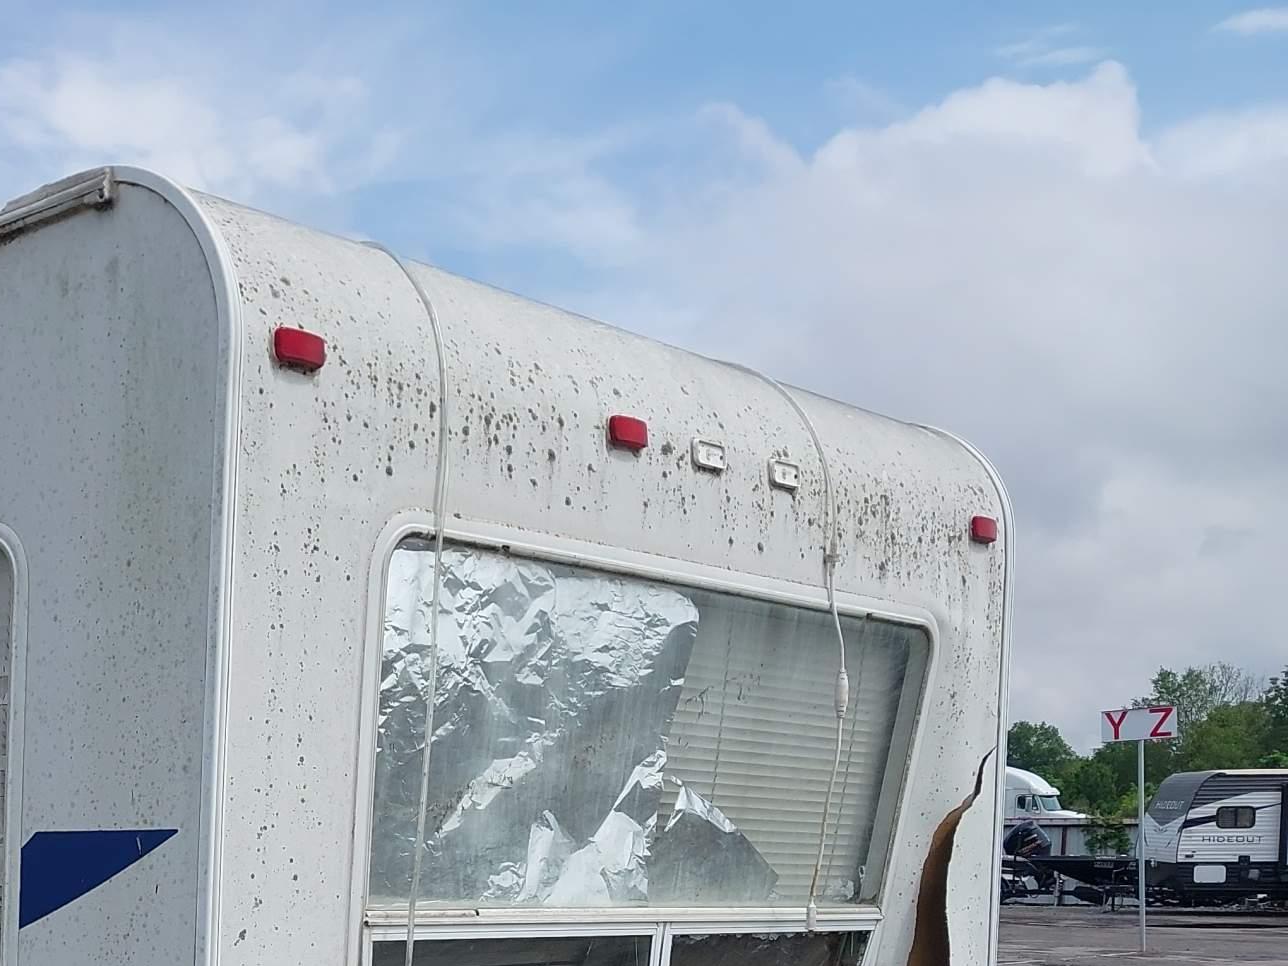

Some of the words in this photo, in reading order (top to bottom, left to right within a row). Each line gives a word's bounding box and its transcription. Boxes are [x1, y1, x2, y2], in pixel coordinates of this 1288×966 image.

[1105, 711, 1128, 740] Y
[1149, 706, 1174, 738] Z
[1154, 800, 1185, 810] HIDEOUT
[1201, 835, 1265, 843] HIDEOUT
